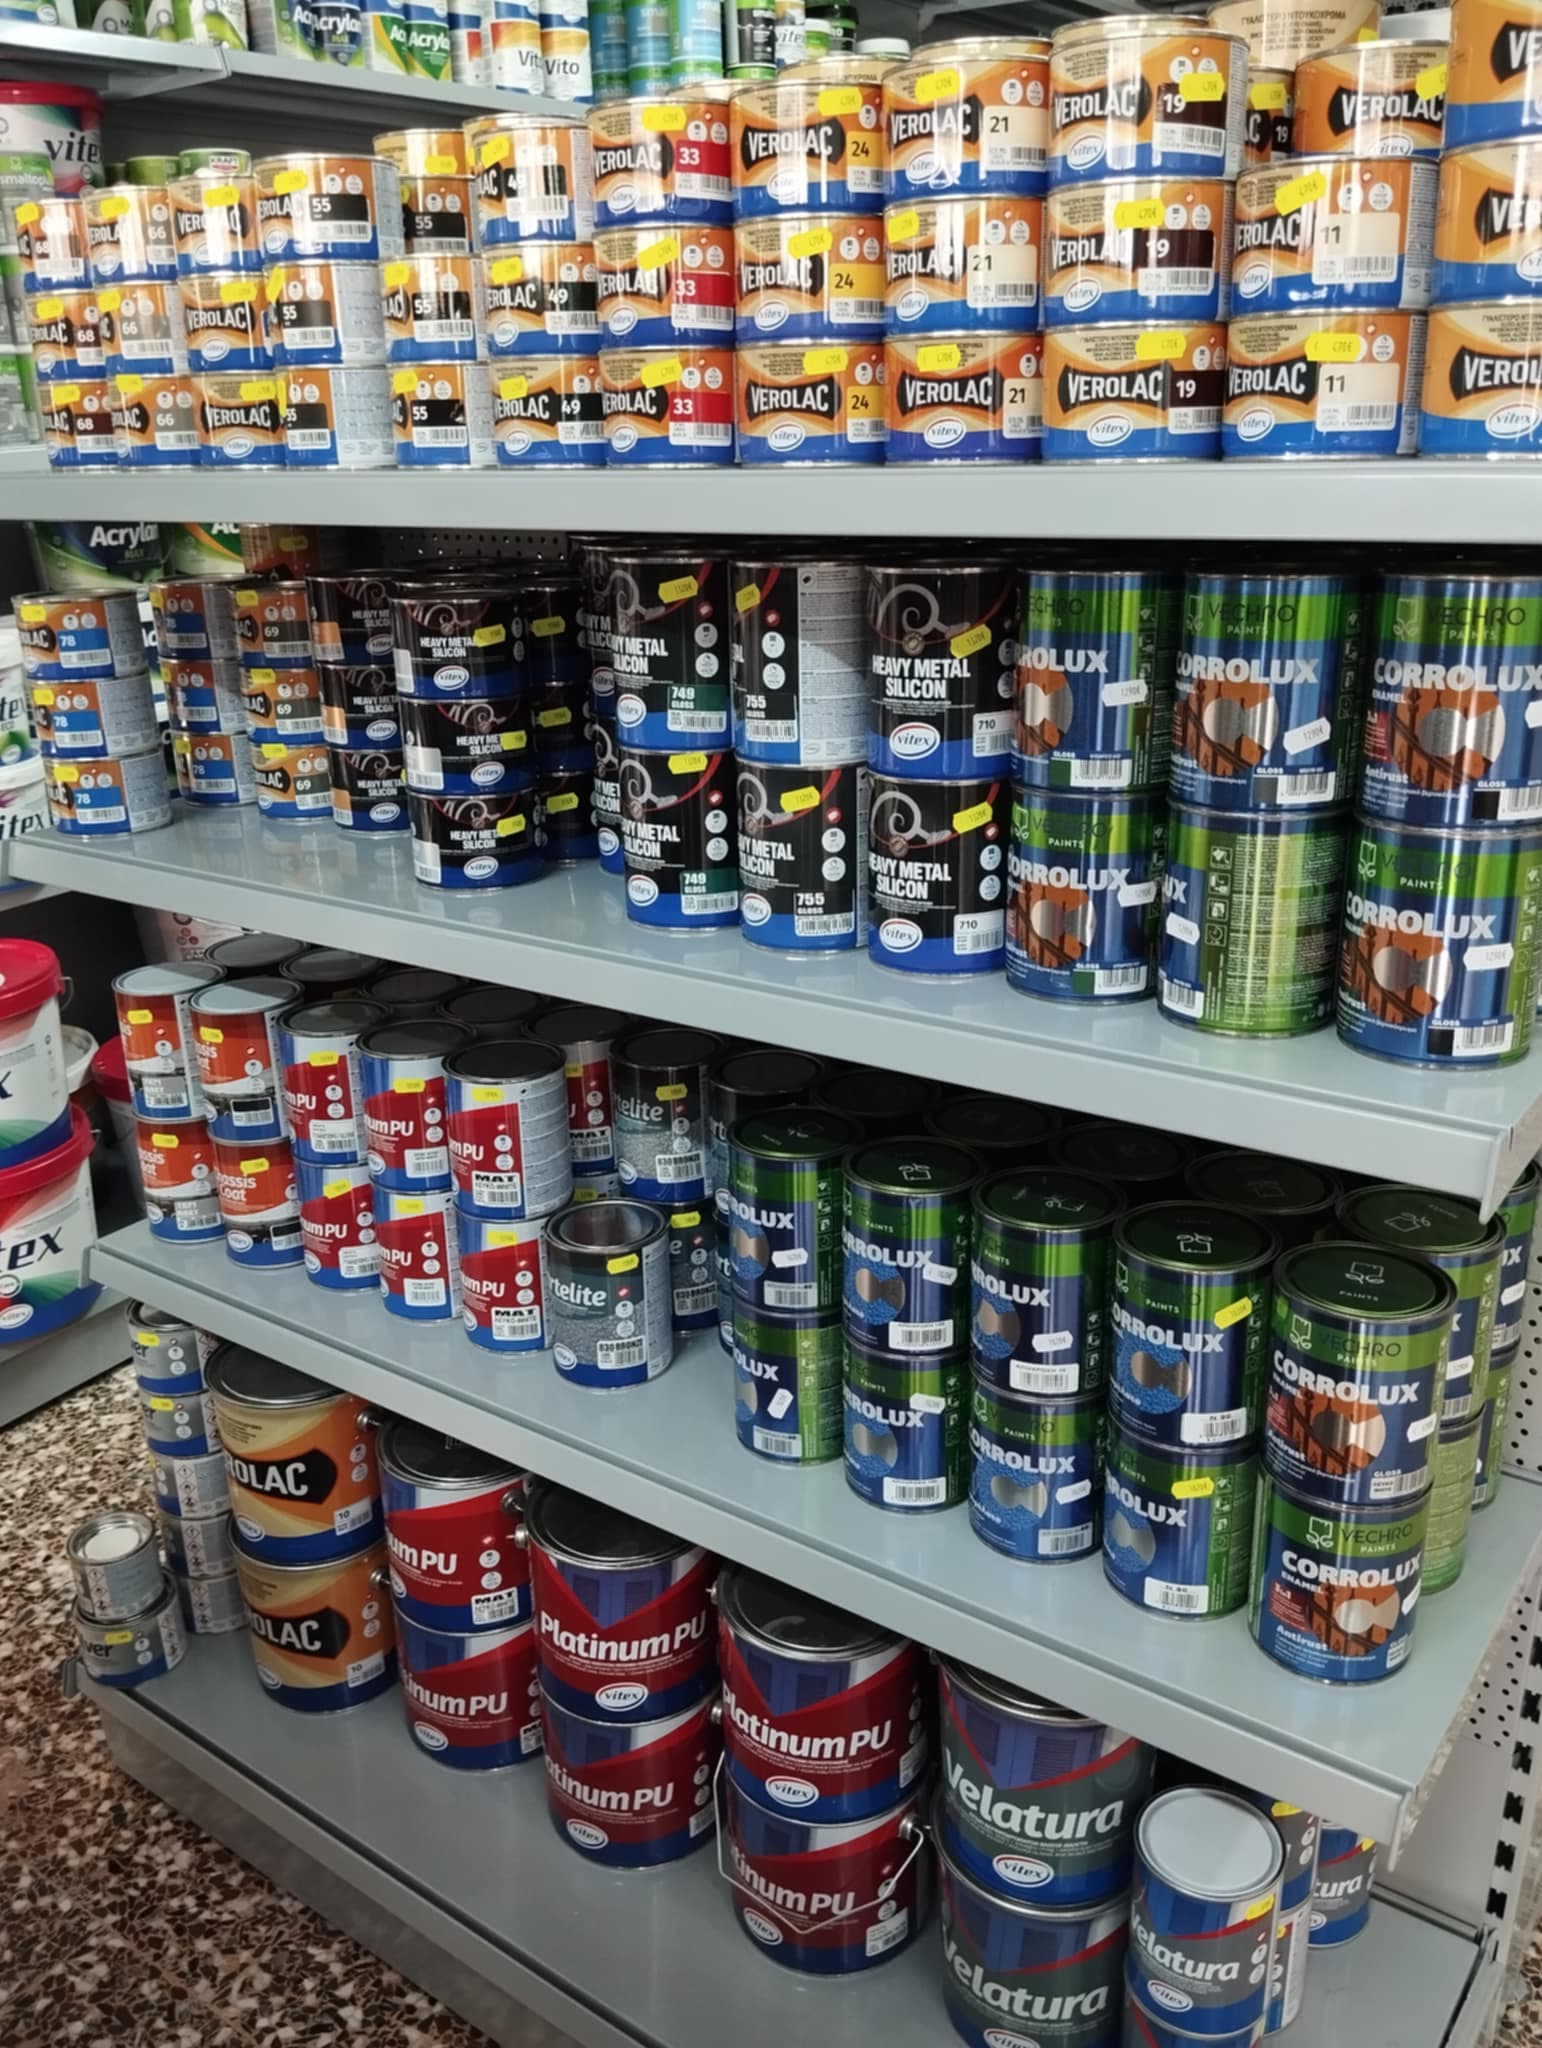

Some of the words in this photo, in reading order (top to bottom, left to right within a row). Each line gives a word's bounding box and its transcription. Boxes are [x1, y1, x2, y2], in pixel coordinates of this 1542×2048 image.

[545, 59, 580, 75] Vito
[1055, 84, 1137, 128] VEROLAC
[1164, 94, 1186, 112] 19
[891, 105, 972, 144] VEROLAC
[990, 116, 1009, 133] 21
[1276, 127, 1288, 142] 19
[748, 124, 833, 161] VEROLAC
[852, 141, 869, 157] 24
[679, 148, 699, 165] 33
[312, 198, 331, 212] 55
[415, 216, 432, 229] 55
[1320, 226, 1341, 244] 11
[1146, 239, 1170, 256] 19
[972, 255, 993, 271] 21
[675, 280, 696, 296] 33
[834, 274, 854, 289] 24
[549, 290, 568, 304] 49
[282, 306, 296, 321] 55
[414, 299, 432, 314] 55
[78, 330, 94, 342] 68
[122, 322, 138, 335] 66
[1067, 369, 1165, 402] VEROLAC
[1229, 362, 1306, 396] VEROLAC
[1325, 376, 1345, 393] 11
[906, 377, 993, 408] VEROLAC
[1009, 388, 1026, 403] 21
[1176, 380, 1196, 398] 19
[751, 384, 829, 413] VEROLAC
[851, 396, 869, 410] 24
[413, 407, 428, 421] 55
[562, 400, 581, 414] 49
[674, 399, 693, 414] 33
[157, 414, 173, 426] 66
[207, 405, 270, 428] VEROLAC
[1243, 416, 1268, 431] vitex
[1489, 412, 1531, 428] vitex
[77, 418, 94, 431] 68
[929, 424, 960, 439] vitex
[1091, 421, 1127, 436] vitex
[1209, 603, 1296, 623] VECHRO
[265, 626, 279, 637] 69
[1228, 626, 1268, 635] PAINTS
[59, 636, 76, 646] 78
[421, 637, 446, 647] HEAVY
[627, 639, 668, 657] METAL
[432, 647, 467, 657] SILICON
[872, 656, 913, 675] HEAVY
[915, 659, 970, 678] METAL
[1177, 651, 1319, 684] CORROLUX
[672, 687, 695, 699] 749
[886, 680, 946, 698] SILICON
[353, 697, 377, 705] HEAVY
[746, 695, 766, 708] 755
[1372, 690, 1407, 704] ENAMEL
[278, 704, 291, 715] 69
[54, 716, 67, 727] 78
[978, 720, 996, 730] 710
[457, 736, 482, 746] HEAVY
[897, 735, 930, 748] vitex
[1256, 767, 1284, 775] GLOSS
[1366, 765, 1408, 784] Antirust
[296, 779, 311, 790] 69
[357, 779, 382, 789] HEAVY
[1478, 780, 1506, 788] GLOSS
[77, 793, 91, 804] 78
[450, 831, 475, 840] HEAVY
[639, 824, 680, 842] METAL
[463, 839, 496, 849] SILICON
[1048, 837, 1084, 848] PAINTS
[752, 842, 794, 860] METAL
[684, 873, 706, 885] 749
[899, 862, 951, 881] METAL
[876, 878, 928, 899] SILICON
[1400, 877, 1443, 890] PAINTS
[797, 892, 824, 906] 755
[1346, 891, 1496, 939] CORROLUX
[959, 920, 978, 929] 710
[885, 929, 912, 942] vitex
[475, 1173, 516, 1182] MAT
[1339, 1290, 1379, 1302] PAINTS
[493, 1307, 537, 1317] MAT
[1145, 1298, 1180, 1314] PAINTS
[1273, 1349, 1421, 1405] CORROLUX
[1004, 1427, 1036, 1442] PAINTS
[1267, 1428, 1307, 1462] Antirust
[1374, 1468, 1402, 1477] GLOSS
[338, 1509, 351, 1520] 10
[1341, 1523, 1413, 1544] VECHRO
[1360, 1543, 1396, 1554] PAINTS
[1281, 1550, 1422, 1589] CORROLUX
[1281, 1571, 1324, 1594] ENAMEL
[473, 1593, 516, 1606] MAT
[541, 1610, 673, 1663] Platinum
[1276, 1624, 1329, 1652] Antirust
[351, 1662, 363, 1673] 10
[604, 1688, 641, 1703] vitex
[417, 1728, 445, 1746] vitex
[772, 1782, 809, 1800] vitex
[944, 1745, 1125, 1841] Velatura
[571, 1824, 603, 1843] vitex
[1003, 1858, 1042, 1881] vitex
[748, 1916, 778, 1939] vitex
[942, 1923, 1110, 2023] Velatura
[1154, 1985, 1184, 2006] vitex
